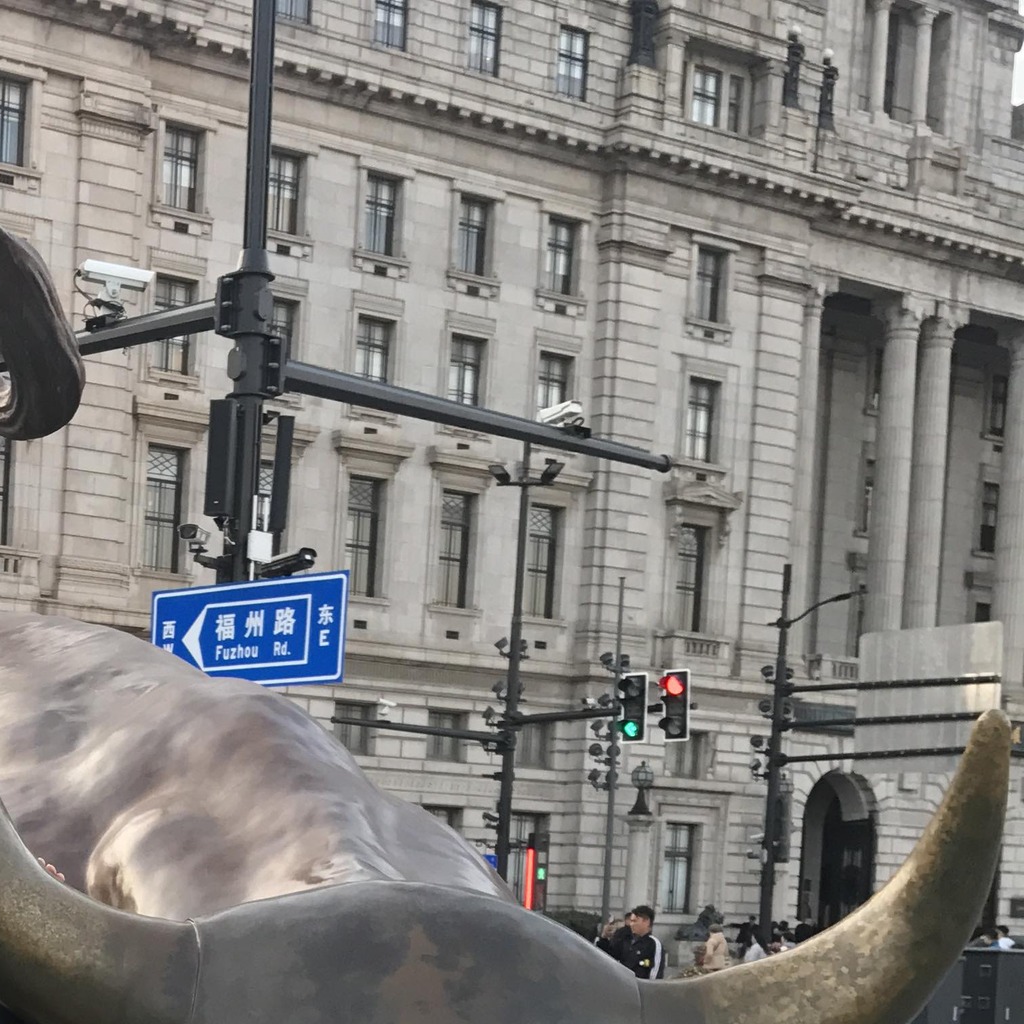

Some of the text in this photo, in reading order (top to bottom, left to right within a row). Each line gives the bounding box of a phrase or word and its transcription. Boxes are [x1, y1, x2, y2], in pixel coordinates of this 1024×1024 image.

[215, 606, 296, 641] 福州路
[318, 604, 334, 625] 东
[162, 620, 176, 639] 西
[319, 630, 330, 646] E
[215, 641, 291, 661] Fuzhou Rd.
